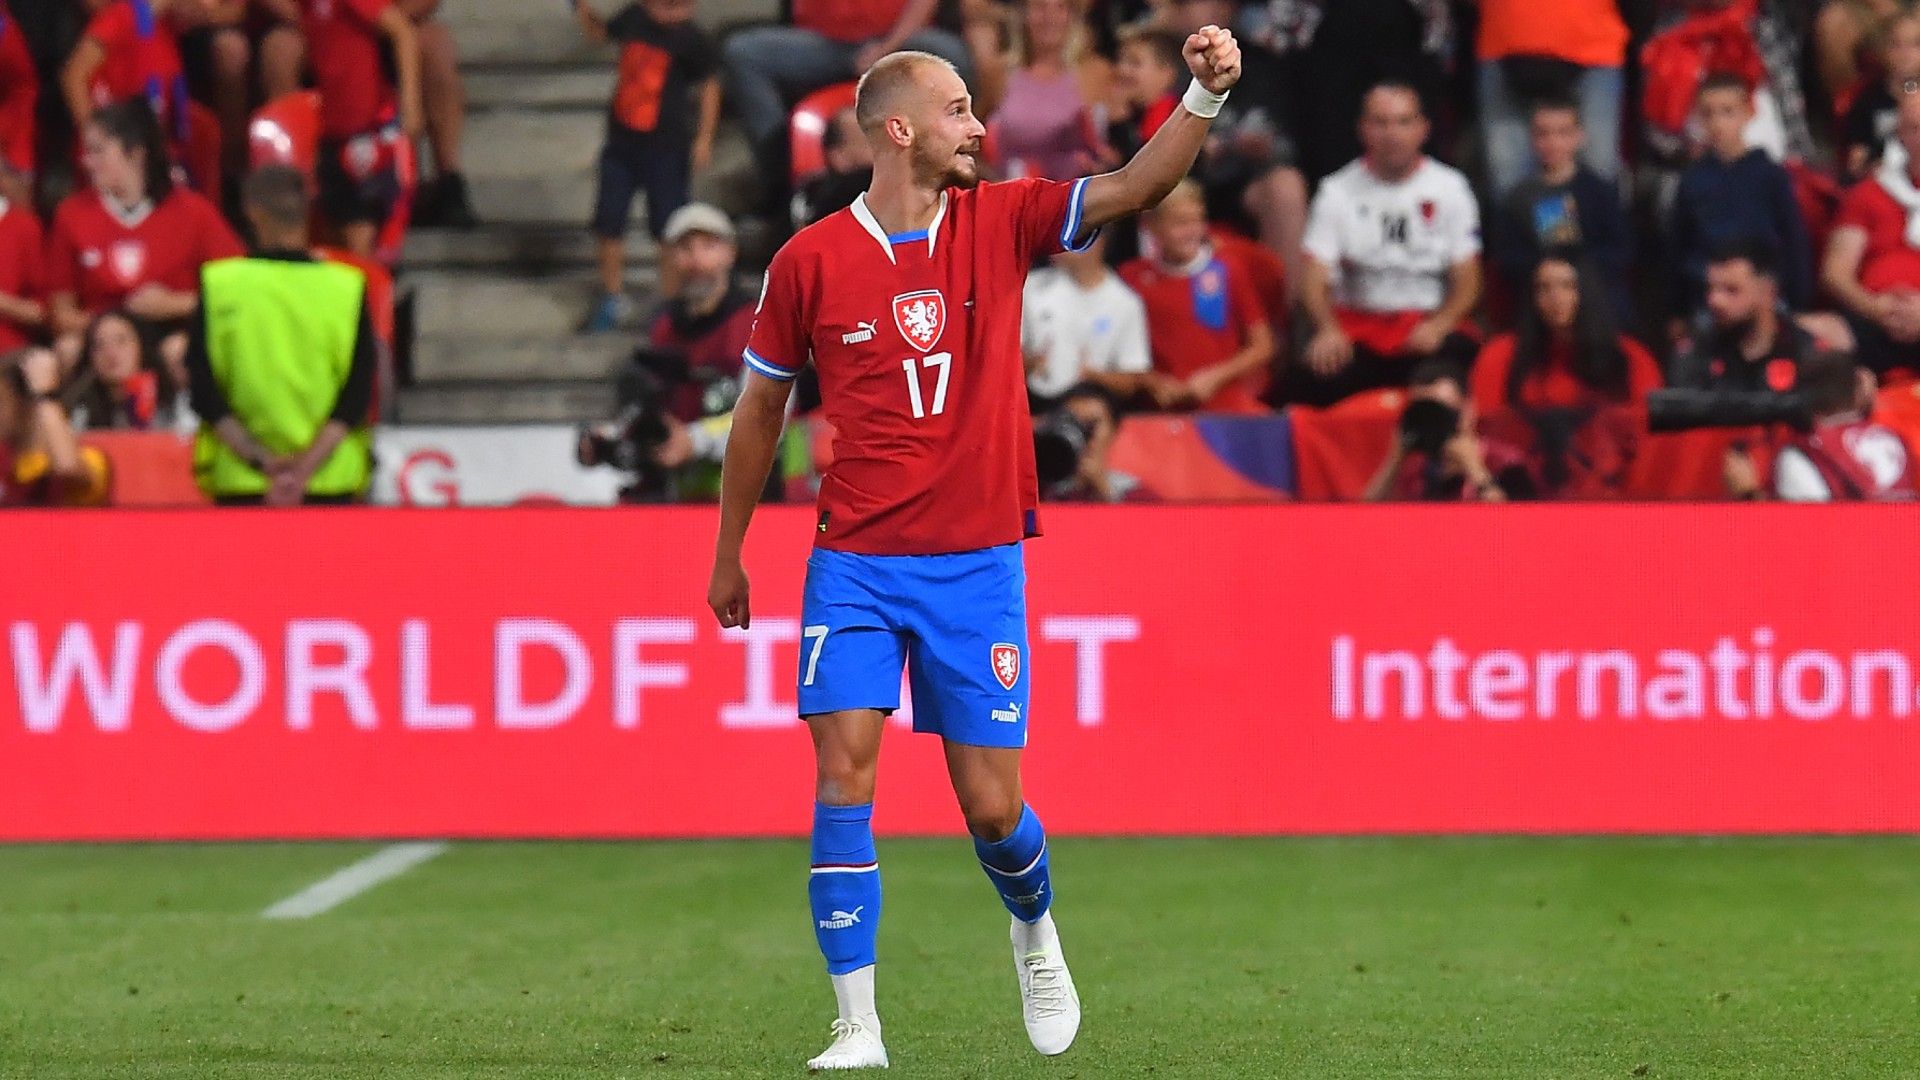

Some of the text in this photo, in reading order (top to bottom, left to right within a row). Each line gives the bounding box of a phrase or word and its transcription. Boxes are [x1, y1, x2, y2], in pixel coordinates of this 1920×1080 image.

[902, 352, 952, 418] 17
[9, 615, 1142, 732] WORLDFIT
[1330, 626, 1920, 720] Internation
[819, 918, 853, 929] PUMA
